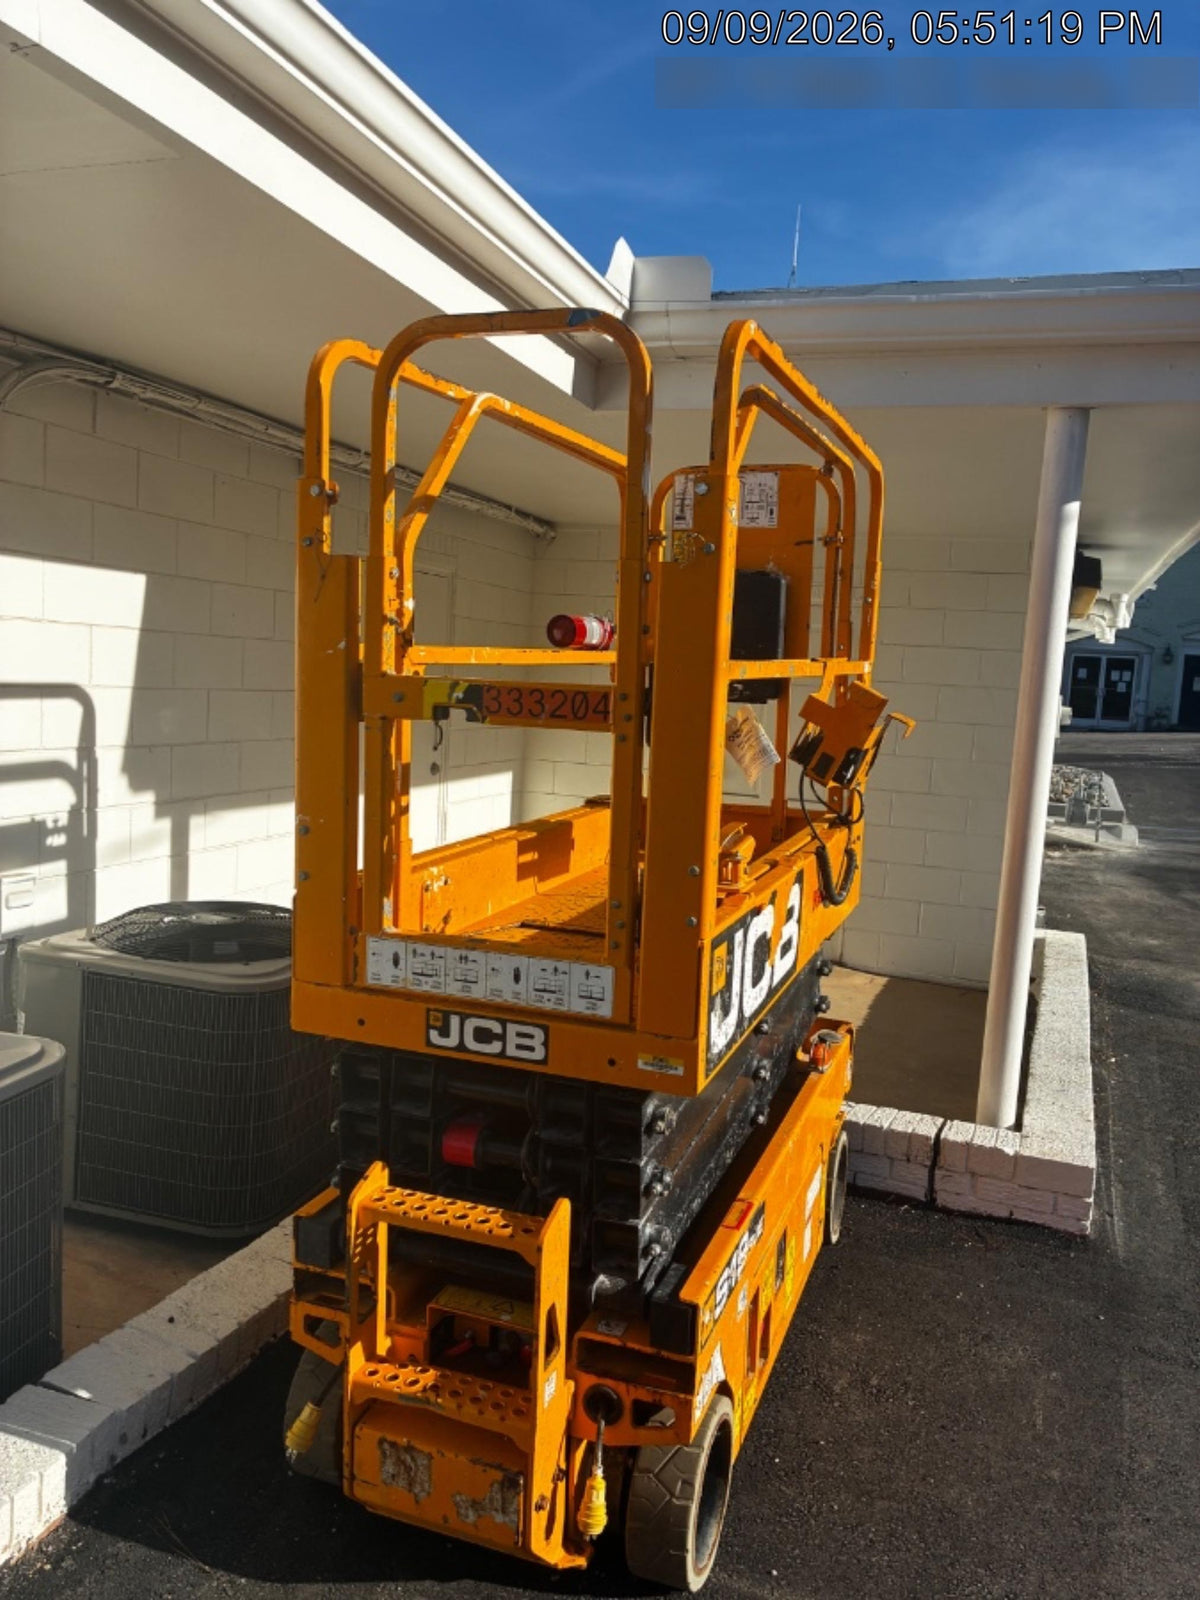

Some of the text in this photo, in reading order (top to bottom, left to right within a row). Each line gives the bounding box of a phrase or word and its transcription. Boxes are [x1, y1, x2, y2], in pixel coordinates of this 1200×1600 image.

[484, 685, 611, 722] 333204
[710, 882, 800, 1054] JCB
[428, 1014, 546, 1061] JCB
